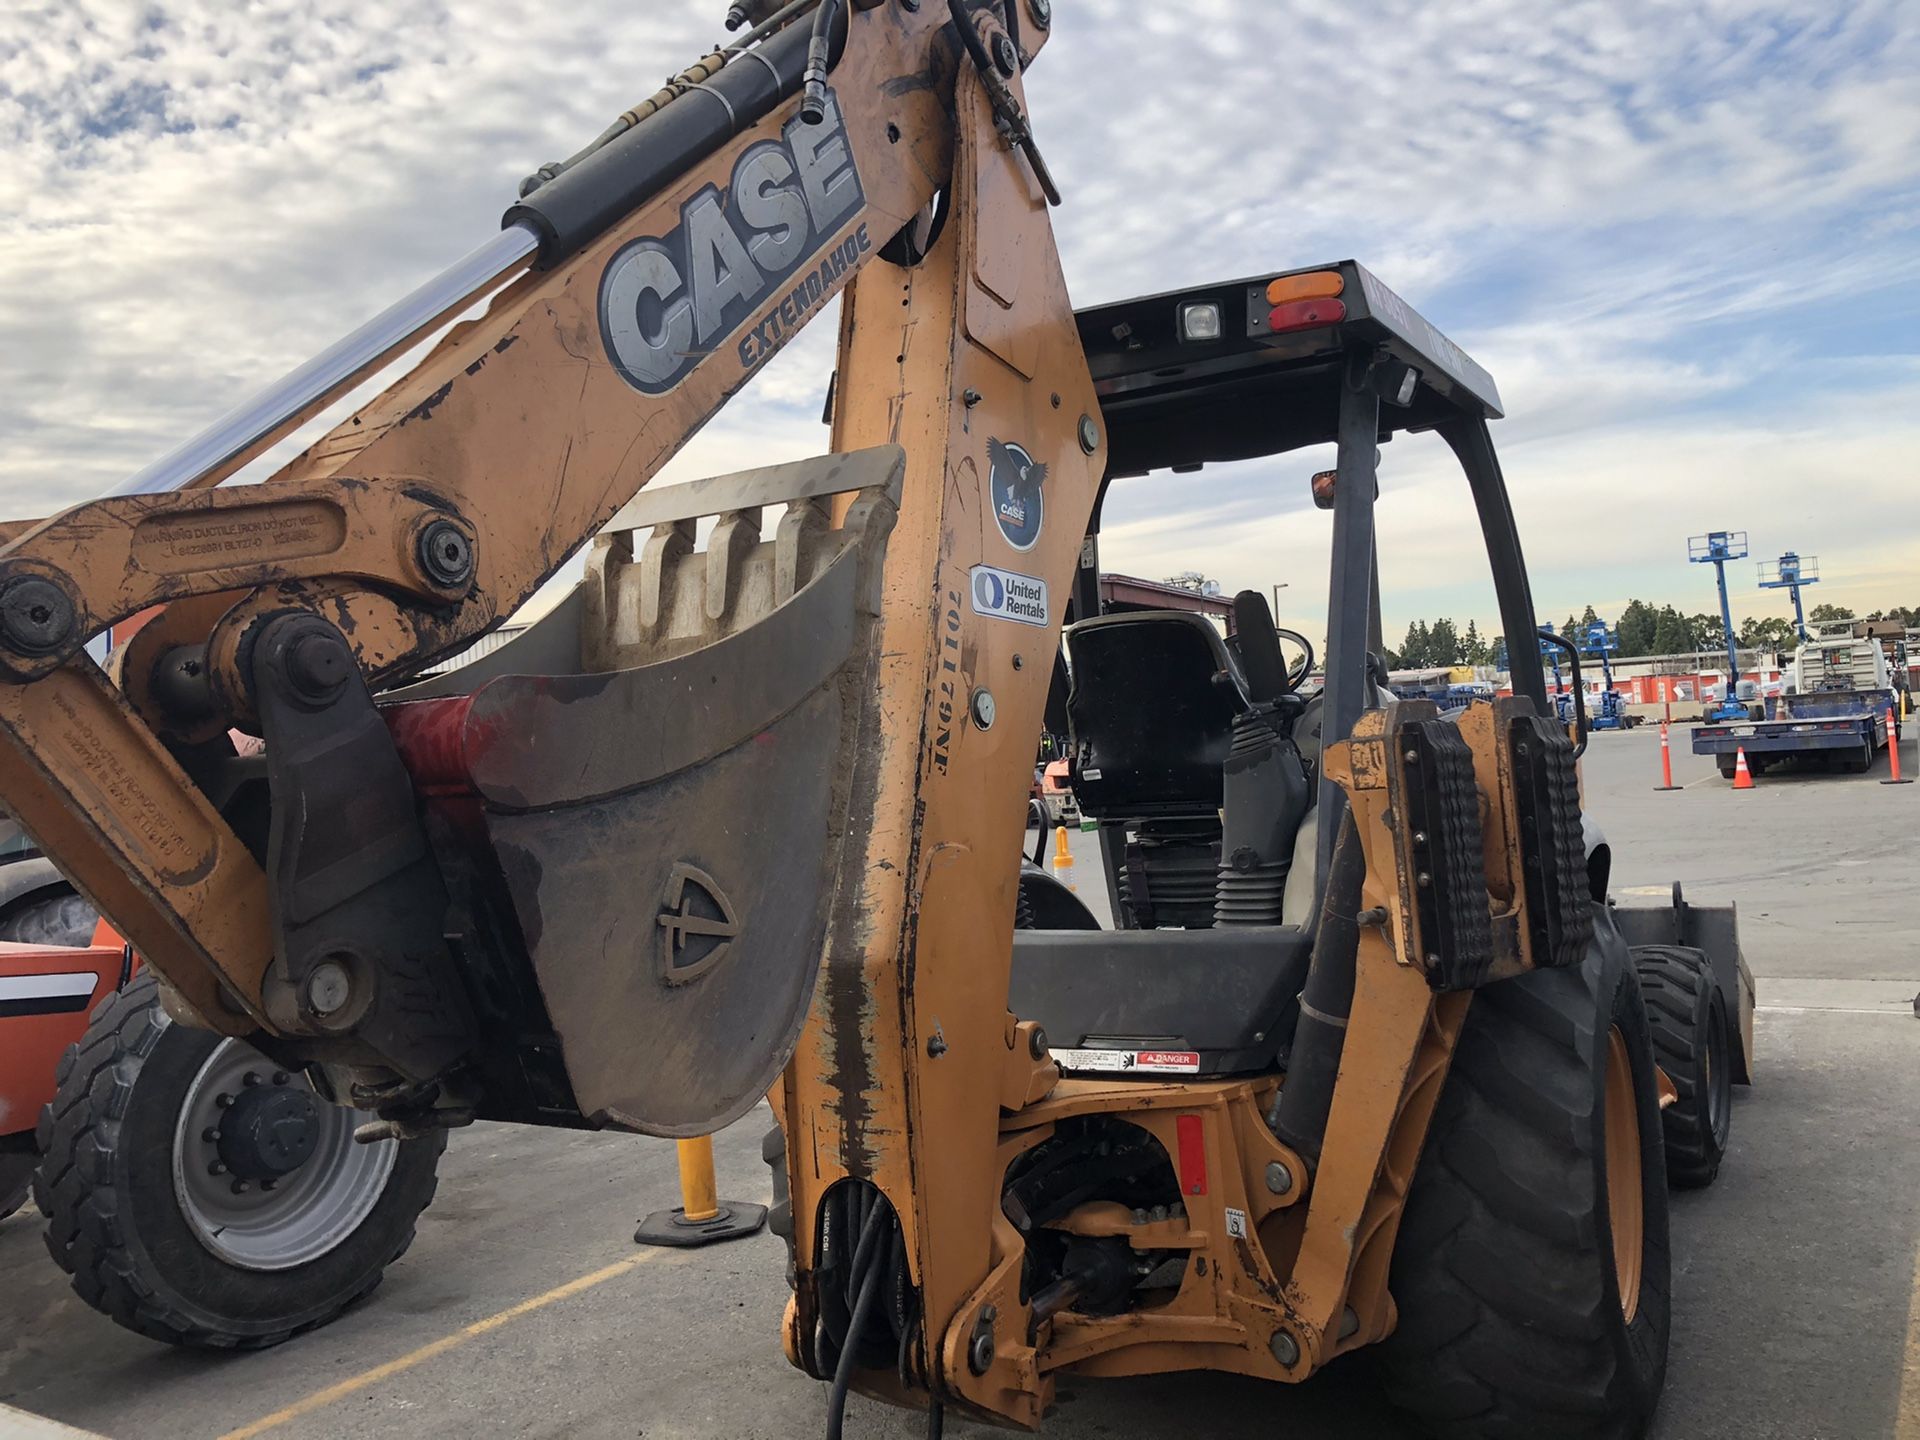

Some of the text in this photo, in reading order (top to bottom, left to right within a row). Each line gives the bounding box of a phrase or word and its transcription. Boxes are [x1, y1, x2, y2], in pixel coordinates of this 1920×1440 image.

[601, 91, 864, 390] CASE
[738, 223, 872, 369] EXTENDAHOE
[1000, 503, 1026, 521] CASE
[1006, 578, 1041, 601] United
[1006, 598, 1046, 619] Rentals
[1156, 1054, 1190, 1065] DANGER
